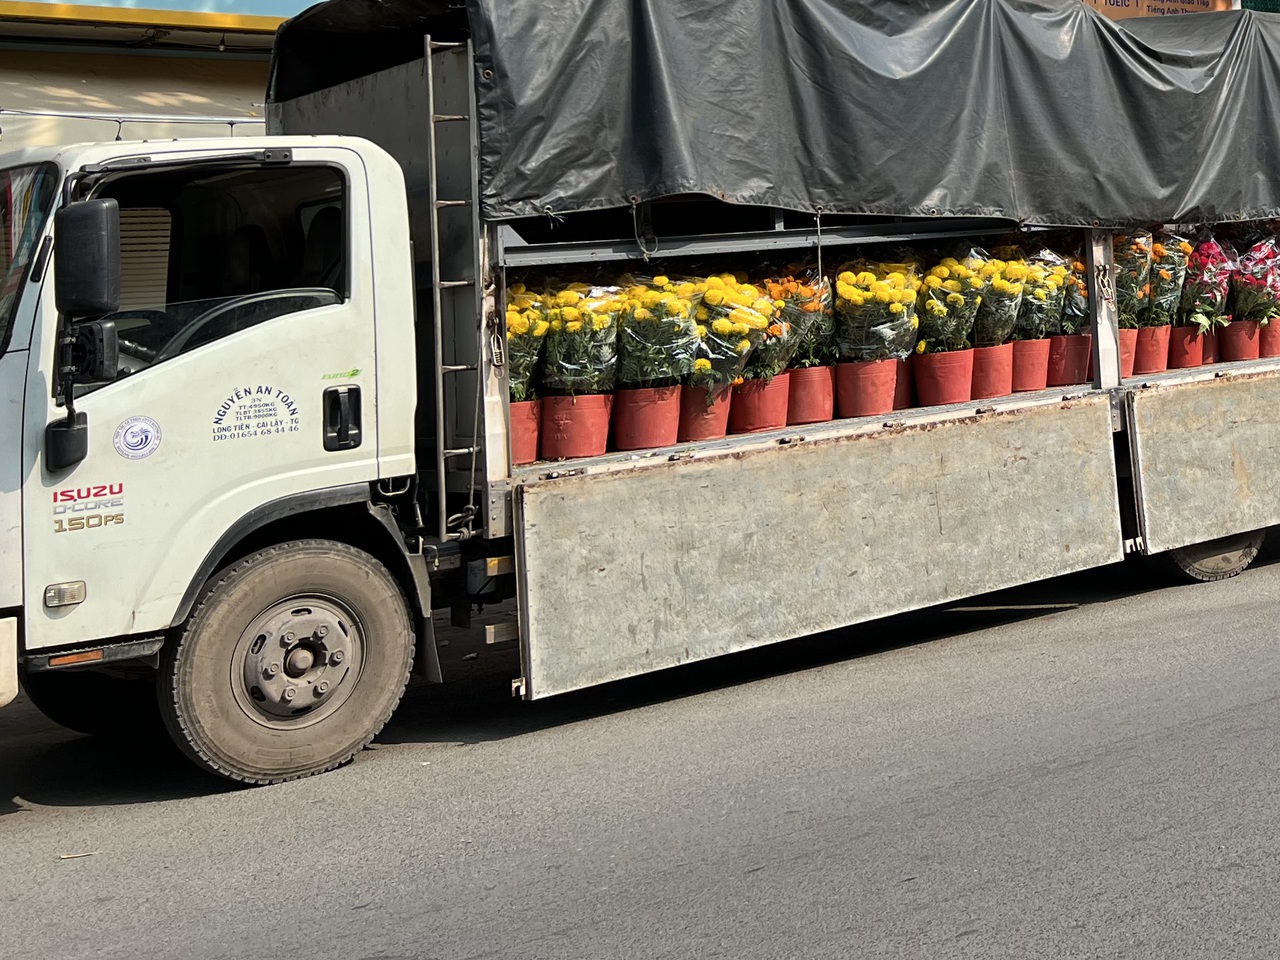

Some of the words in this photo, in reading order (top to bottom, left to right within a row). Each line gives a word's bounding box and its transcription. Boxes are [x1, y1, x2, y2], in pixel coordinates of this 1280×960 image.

[256, 385, 273, 396] AN
[212, 425, 232, 434] LONG
[257, 421, 268, 429] CAI
[261, 427, 272, 436] 68
[274, 426, 285, 435] 44
[288, 425, 299, 433] 46
[53, 482, 123, 503] ISUZU
[53, 497, 124, 515] D-CORE
[54, 513, 124, 533] 150PS
